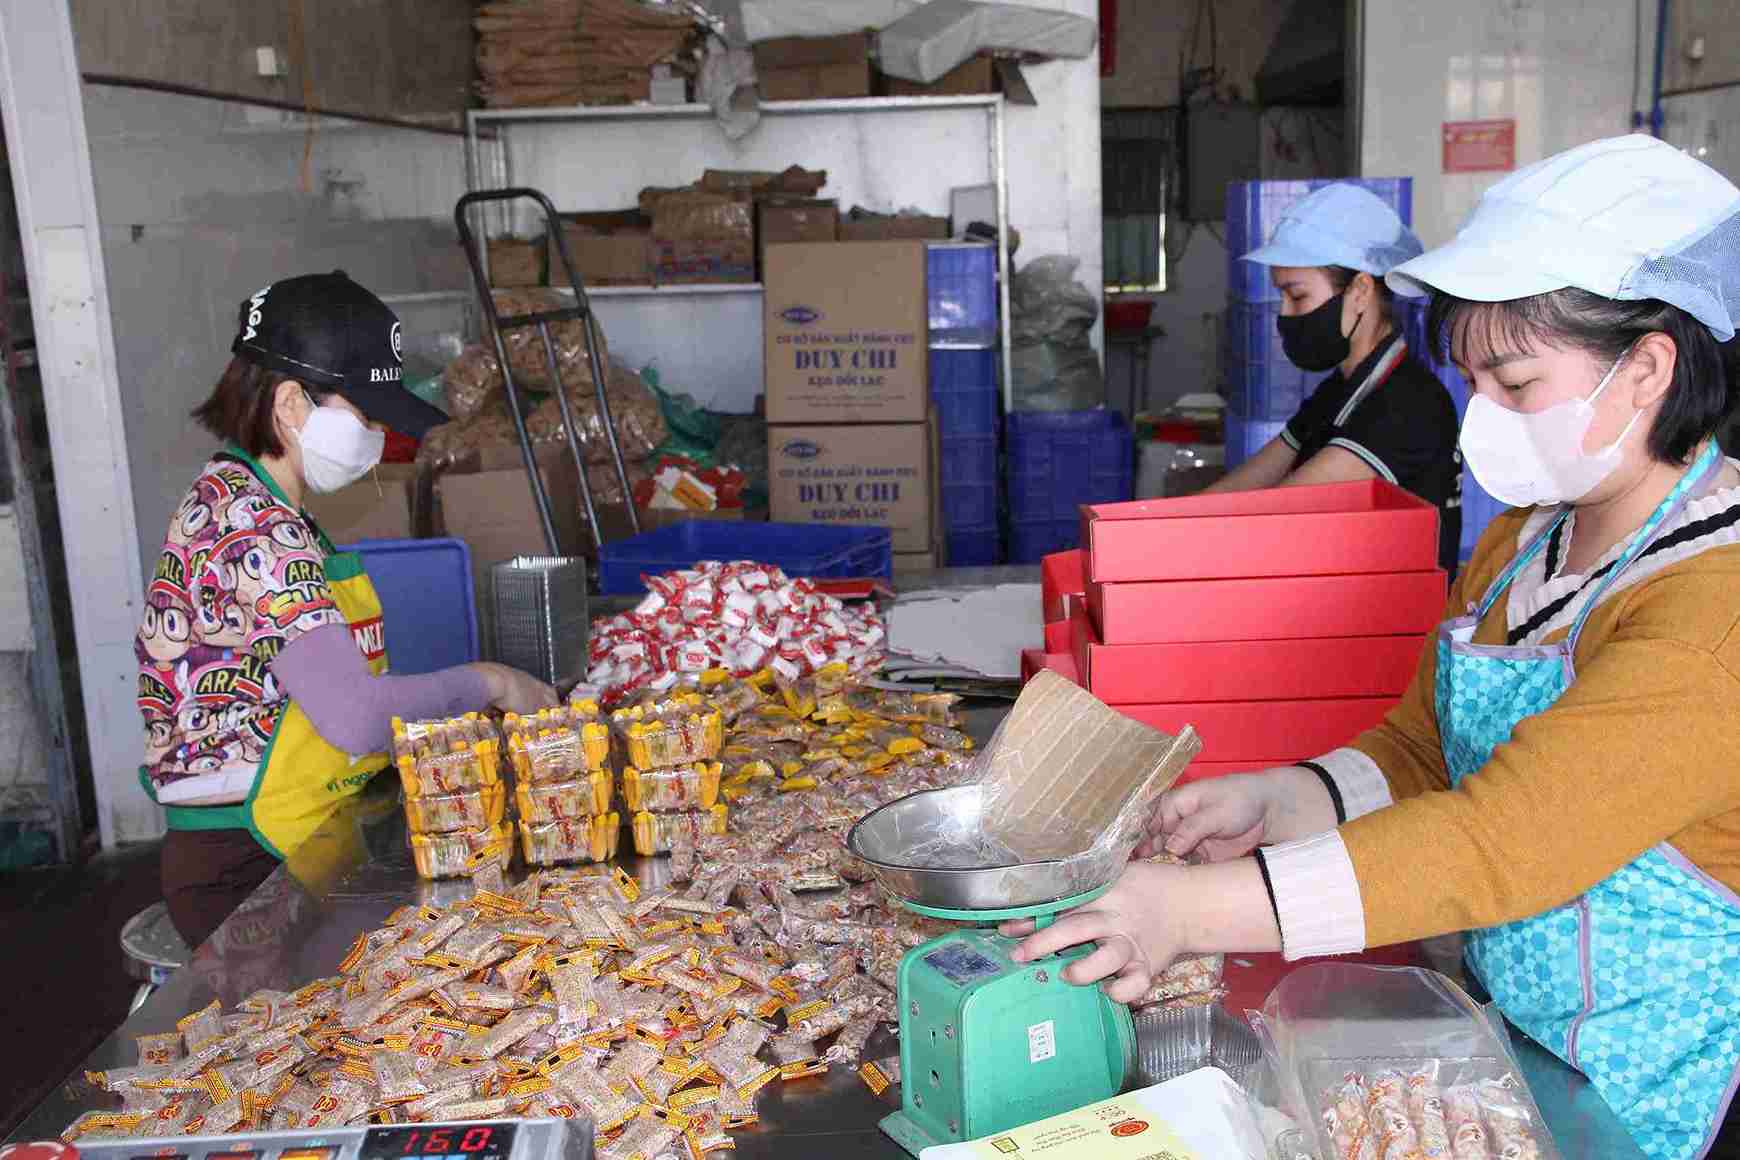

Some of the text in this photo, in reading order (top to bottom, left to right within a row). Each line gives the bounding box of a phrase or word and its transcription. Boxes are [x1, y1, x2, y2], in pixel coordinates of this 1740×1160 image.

[795, 349, 897, 369] DUY CHI
[799, 482, 900, 502] DUY CHI
